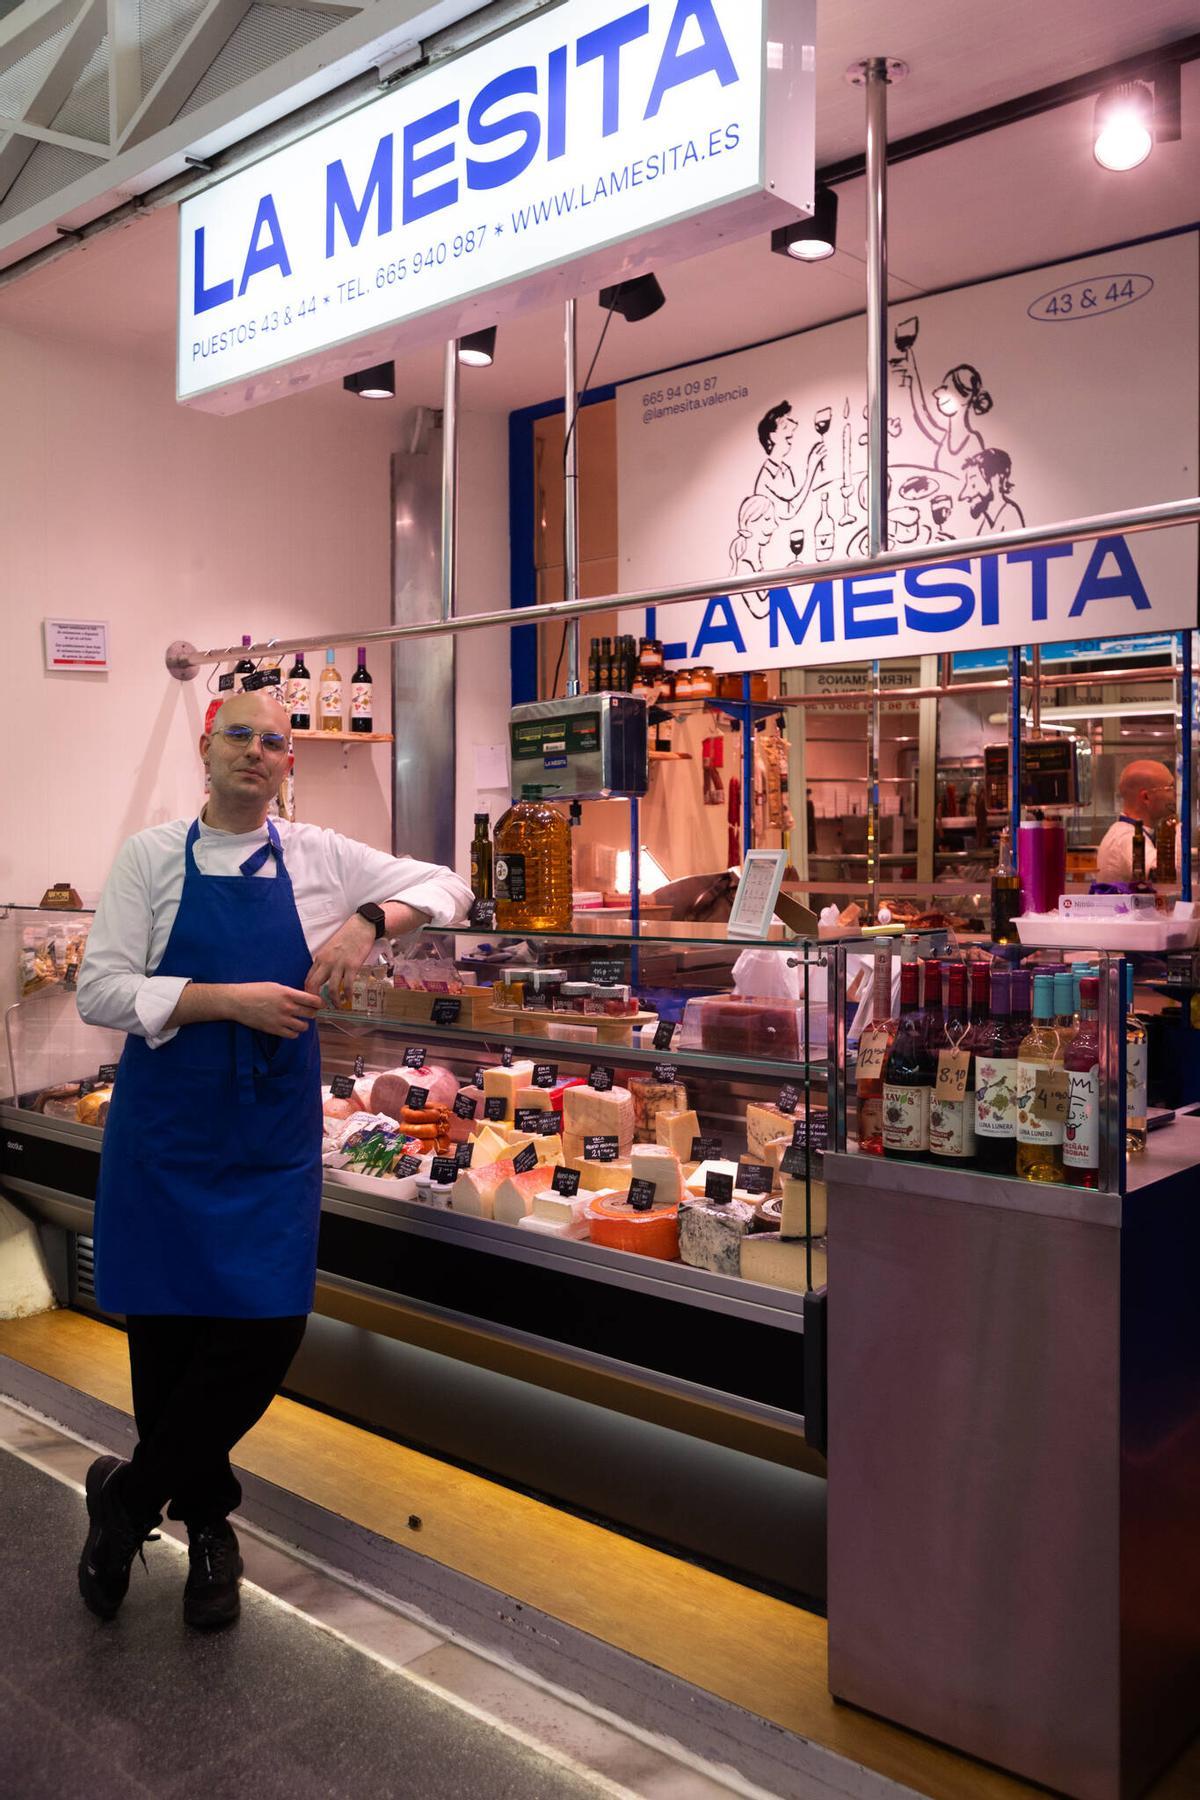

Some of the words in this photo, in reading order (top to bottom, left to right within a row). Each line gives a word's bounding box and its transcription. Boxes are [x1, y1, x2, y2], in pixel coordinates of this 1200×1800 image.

[194, 193, 292, 316] LA
[324, 0, 740, 260] MESITA
[192, 320, 257, 362] PUESTOS
[261, 314, 280, 333] 43
[284, 305, 293, 326] &
[297, 295, 317, 318] 44
[337, 275, 371, 304] TEL.
[375, 257, 408, 290] 665
[412, 241, 448, 276] 940
[452, 224, 487, 259] 987
[511, 122, 741, 235] WWW.LAMESITA.ES
[1045, 293, 1073, 316] 43
[1080, 287, 1098, 309] &
[1104, 279, 1135, 302] 44
[642, 390, 664, 407] 665
[666, 386, 682, 400] 94
[684, 381, 701, 396] 09
[703, 376, 718, 391] 87
[642, 386, 750, 425] @lamesita.valencia
[645, 595, 747, 660] LA
[769, 534, 1152, 648] MESITA
